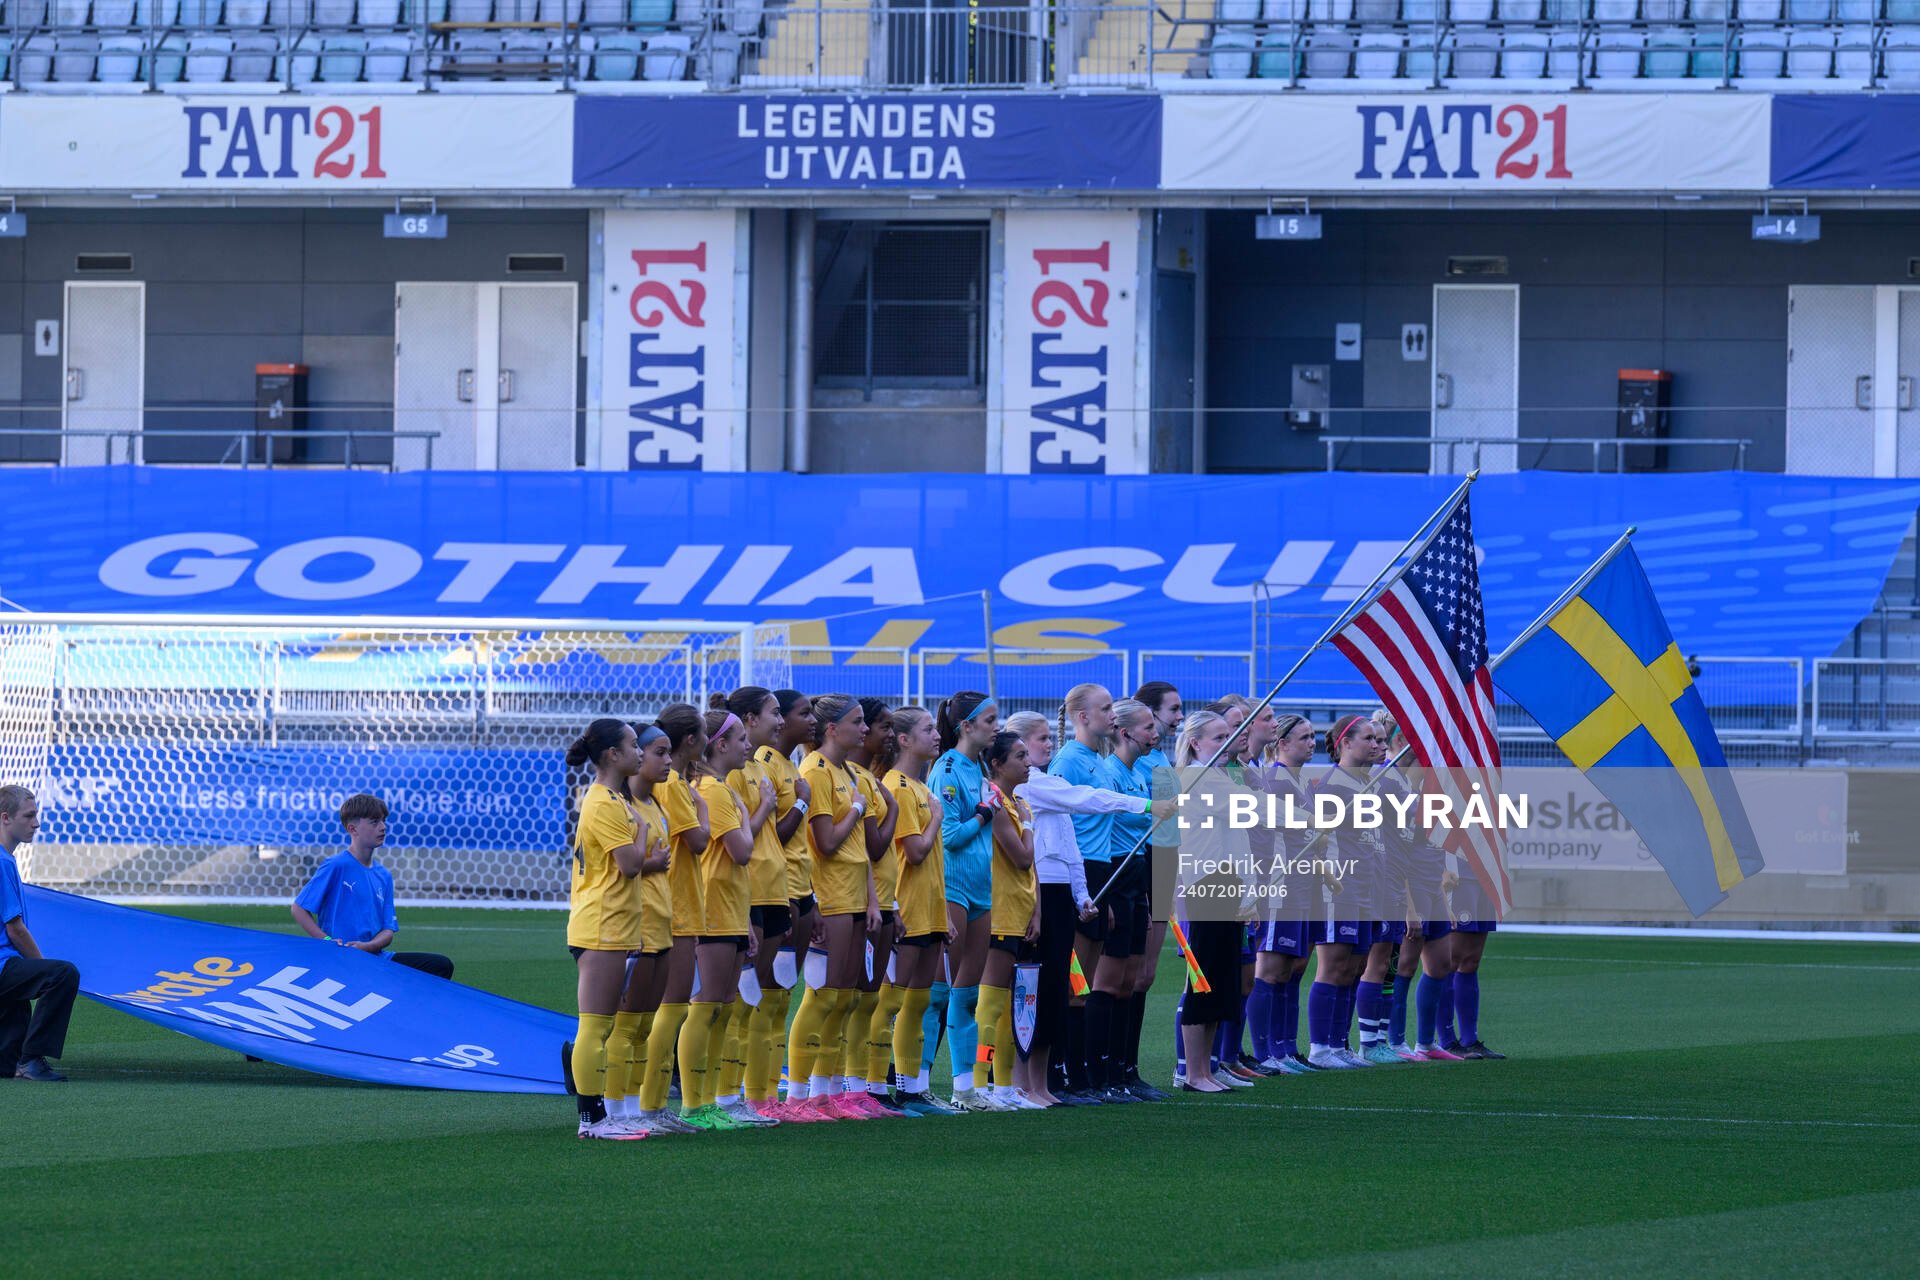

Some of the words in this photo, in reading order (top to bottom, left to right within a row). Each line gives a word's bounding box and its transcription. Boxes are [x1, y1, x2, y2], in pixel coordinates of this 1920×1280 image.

[181, 105, 387, 179] FAT21
[738, 104, 996, 138] LEGENDENS
[1355, 104, 1573, 179] FAT21
[765, 145, 966, 180] UTVALDA
[403, 217, 428, 234] G5
[628, 240, 707, 471] FAT21
[1030, 240, 1110, 474] FAT21
[98, 531, 925, 606] GOTHIA
[256, 785, 352, 811] frictio
